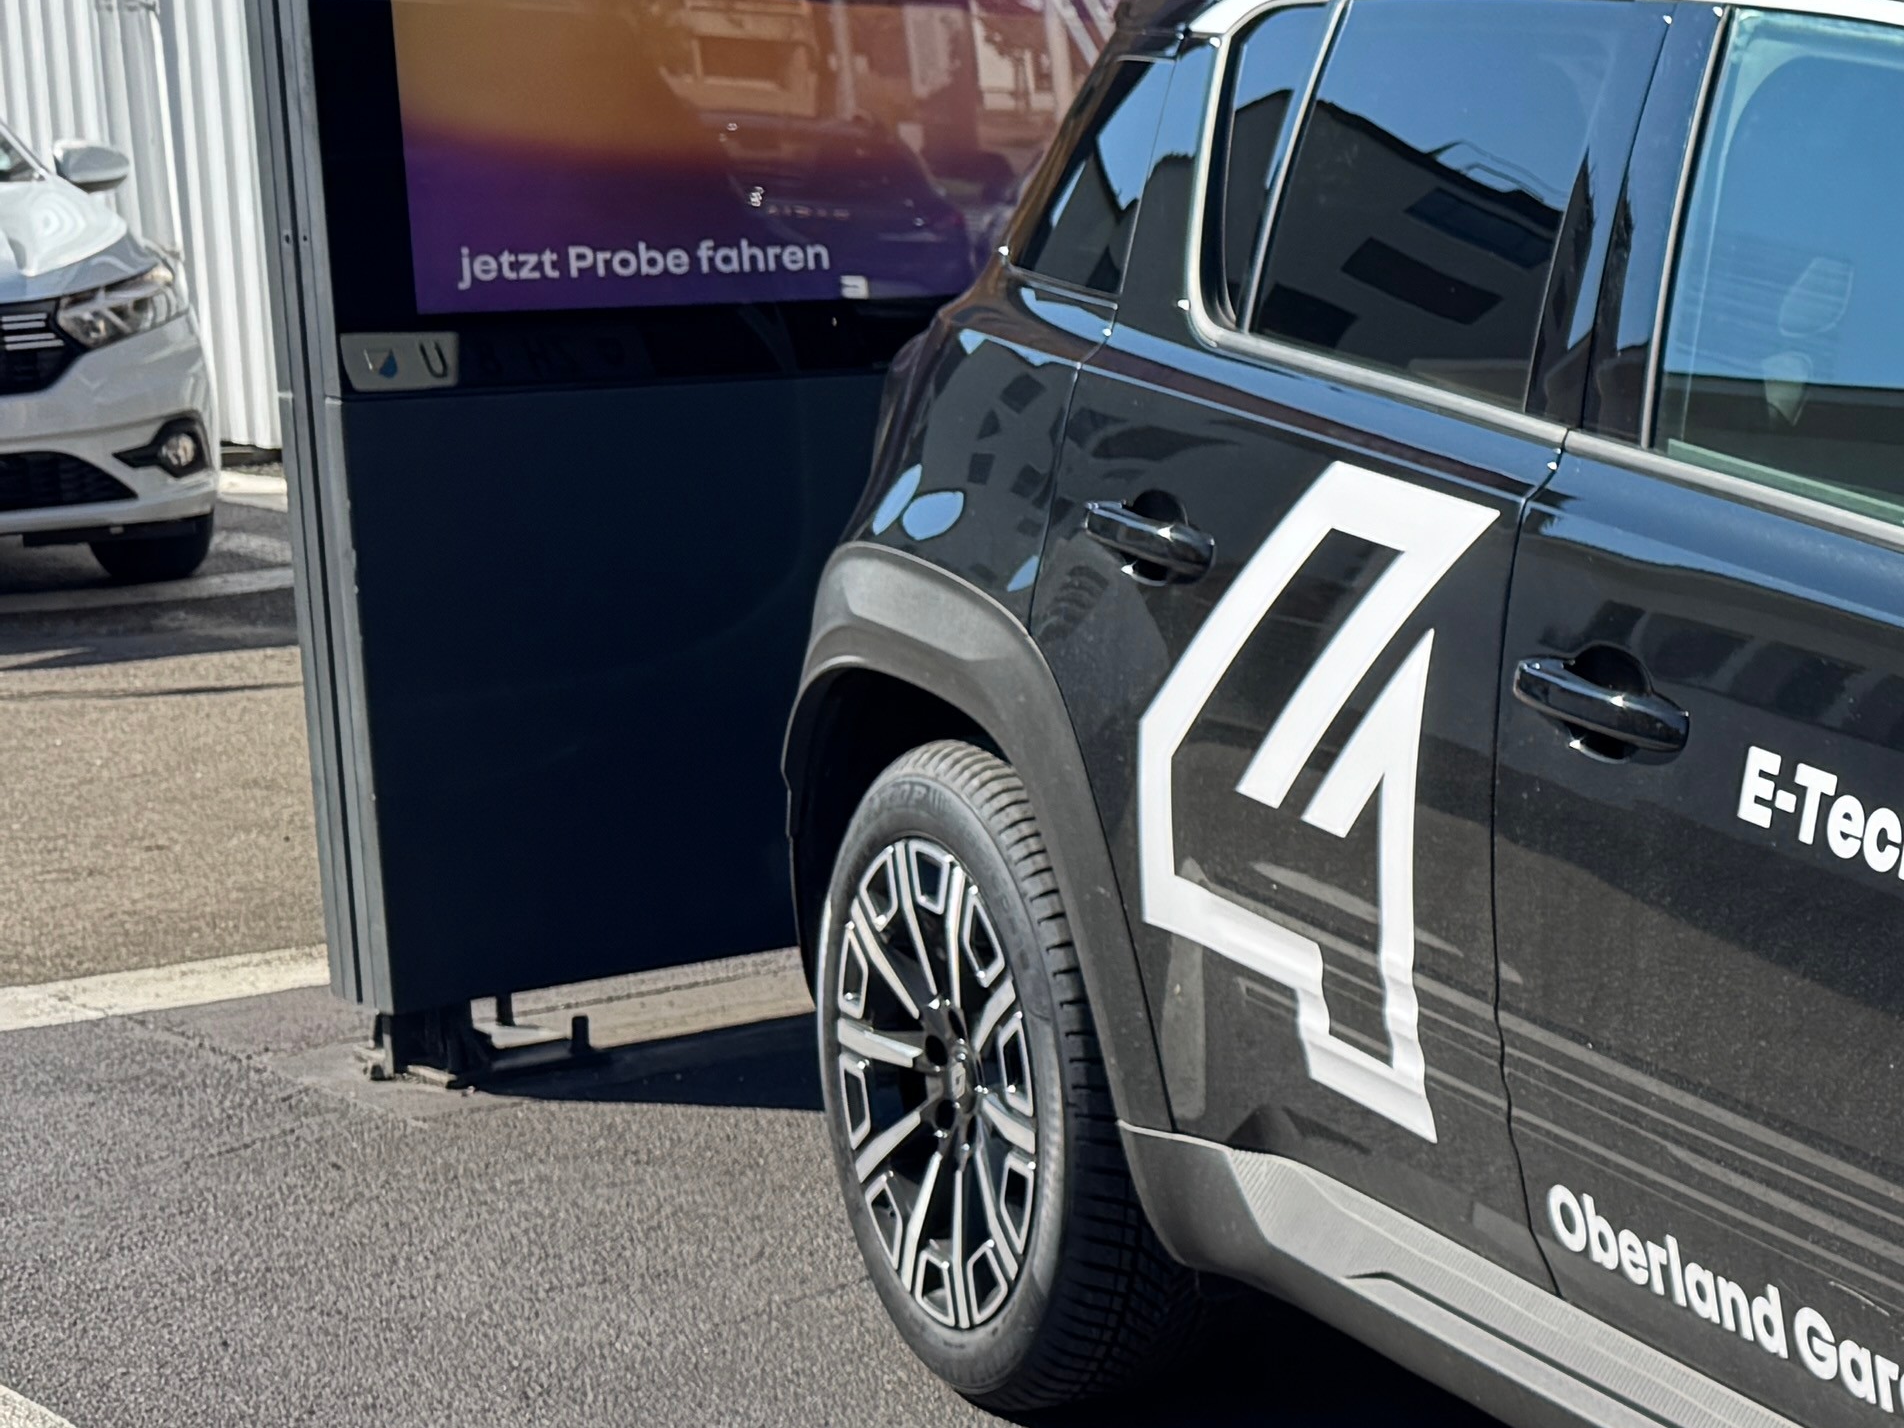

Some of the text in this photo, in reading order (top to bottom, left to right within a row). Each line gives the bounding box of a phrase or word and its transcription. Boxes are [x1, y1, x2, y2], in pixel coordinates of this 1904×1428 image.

[458, 239, 830, 290] jetzt Probe fahren
[1547, 1184, 1788, 1359] Oberland
